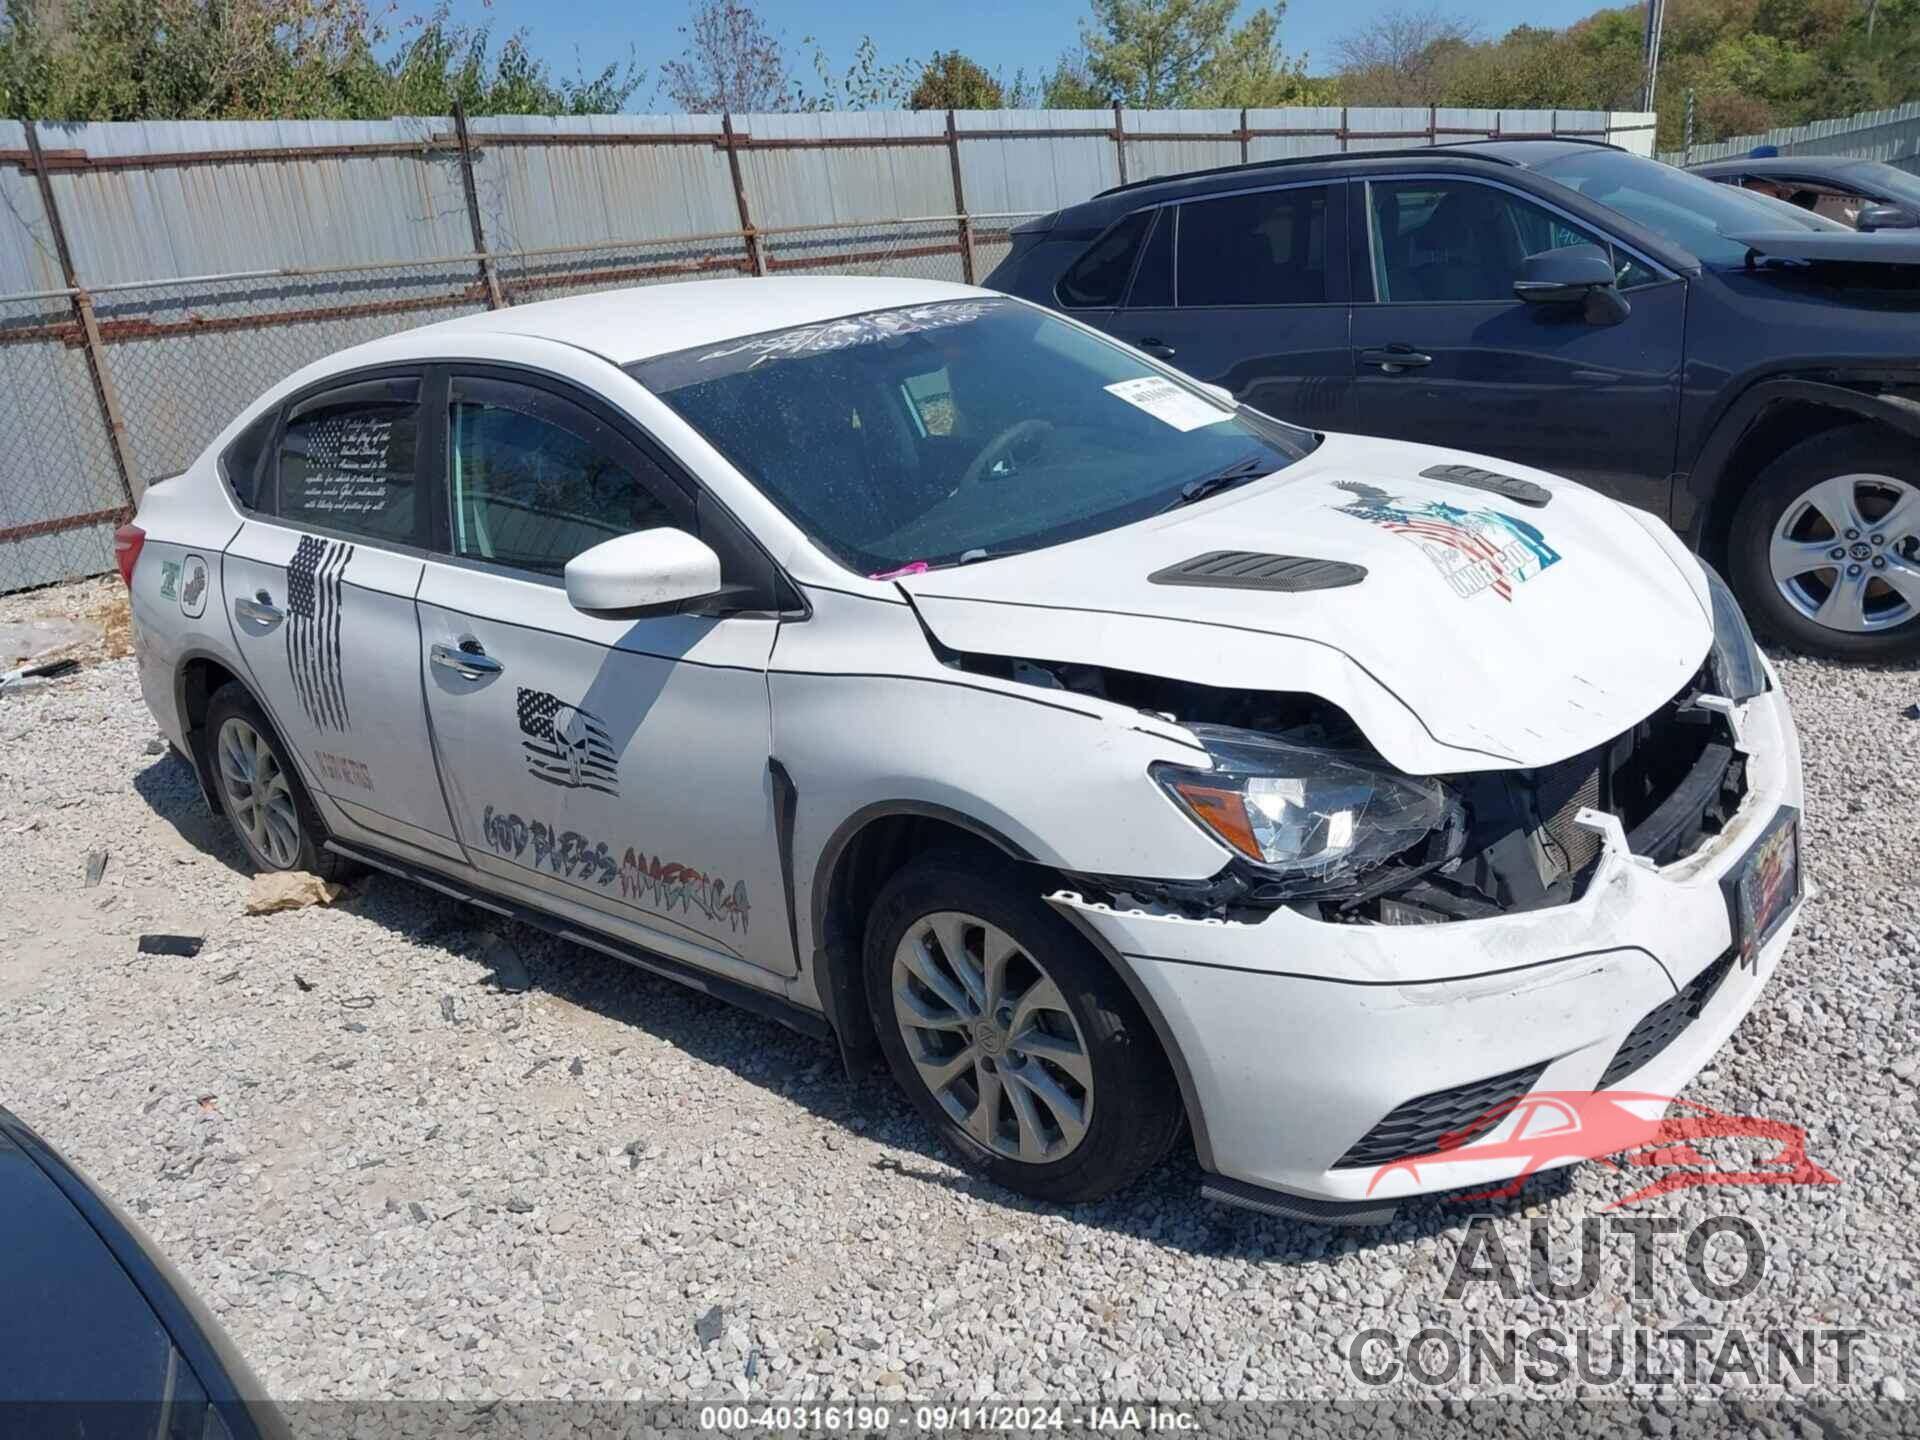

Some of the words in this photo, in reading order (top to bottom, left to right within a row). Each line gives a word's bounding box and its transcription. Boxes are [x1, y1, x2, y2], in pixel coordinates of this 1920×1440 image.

[483, 805, 529, 860] GOD
[529, 819, 618, 887] BLESS
[617, 847, 752, 935] AMERICA
